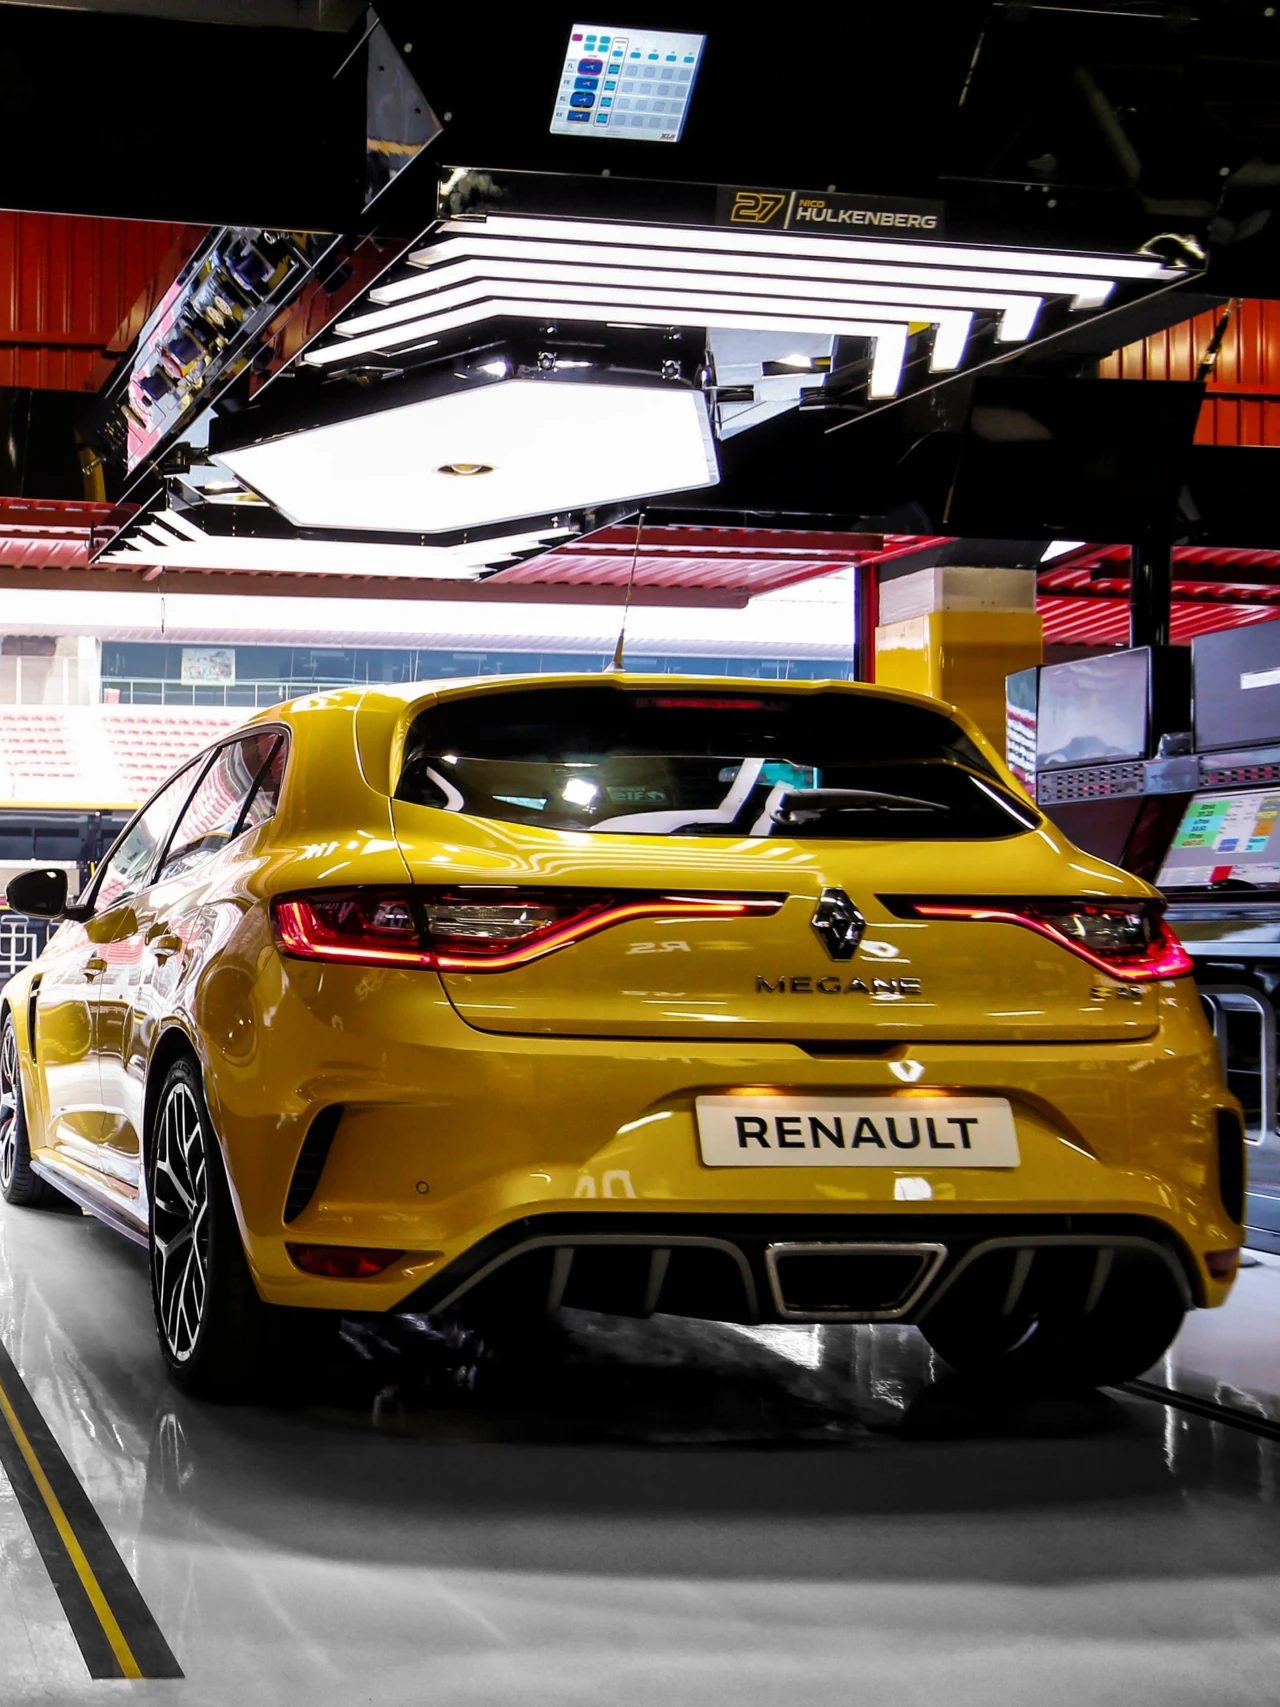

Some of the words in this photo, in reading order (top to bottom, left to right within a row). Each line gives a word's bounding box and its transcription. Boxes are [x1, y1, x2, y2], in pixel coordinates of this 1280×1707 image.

[730, 192, 786, 223] 27
[799, 199, 826, 208] NICO
[796, 206, 937, 229] HULKENBERG
[756, 975, 922, 996] MEGANE
[734, 1115, 979, 1150] RENAULT
